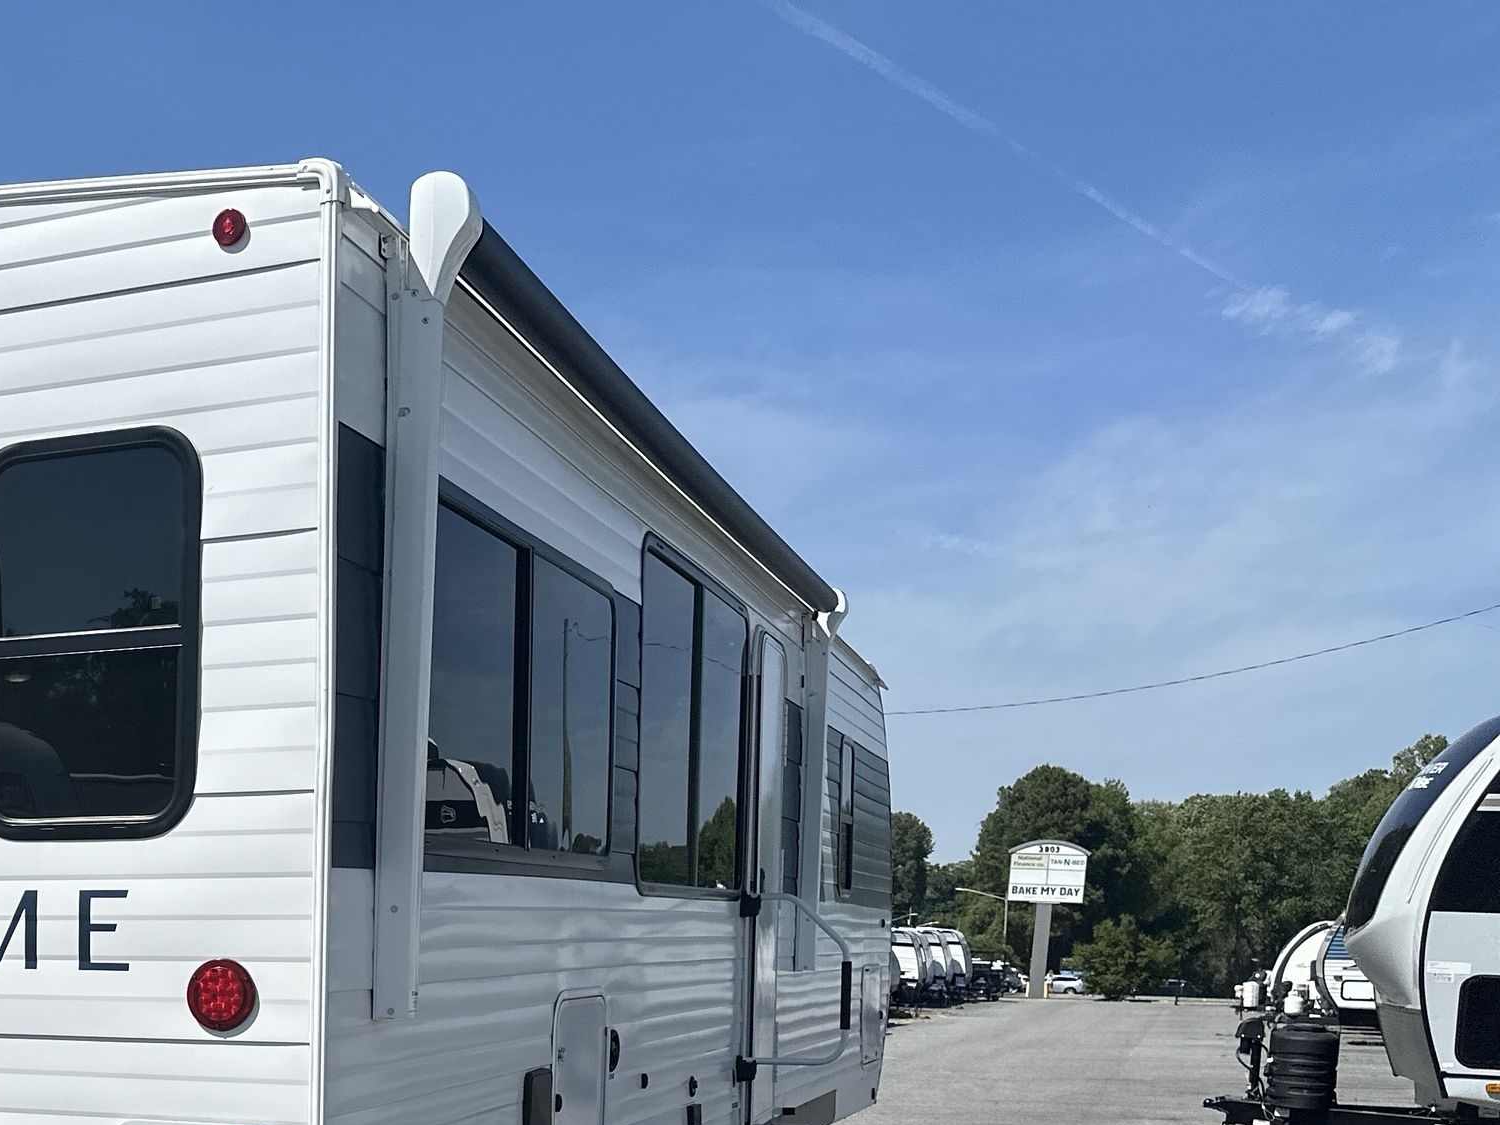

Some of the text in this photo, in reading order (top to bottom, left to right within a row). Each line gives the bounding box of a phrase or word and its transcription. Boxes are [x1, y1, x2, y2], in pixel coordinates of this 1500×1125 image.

[1050, 858, 1086, 867] TAN-N-BED
[1011, 885, 1081, 897] BAKE MY DAY
